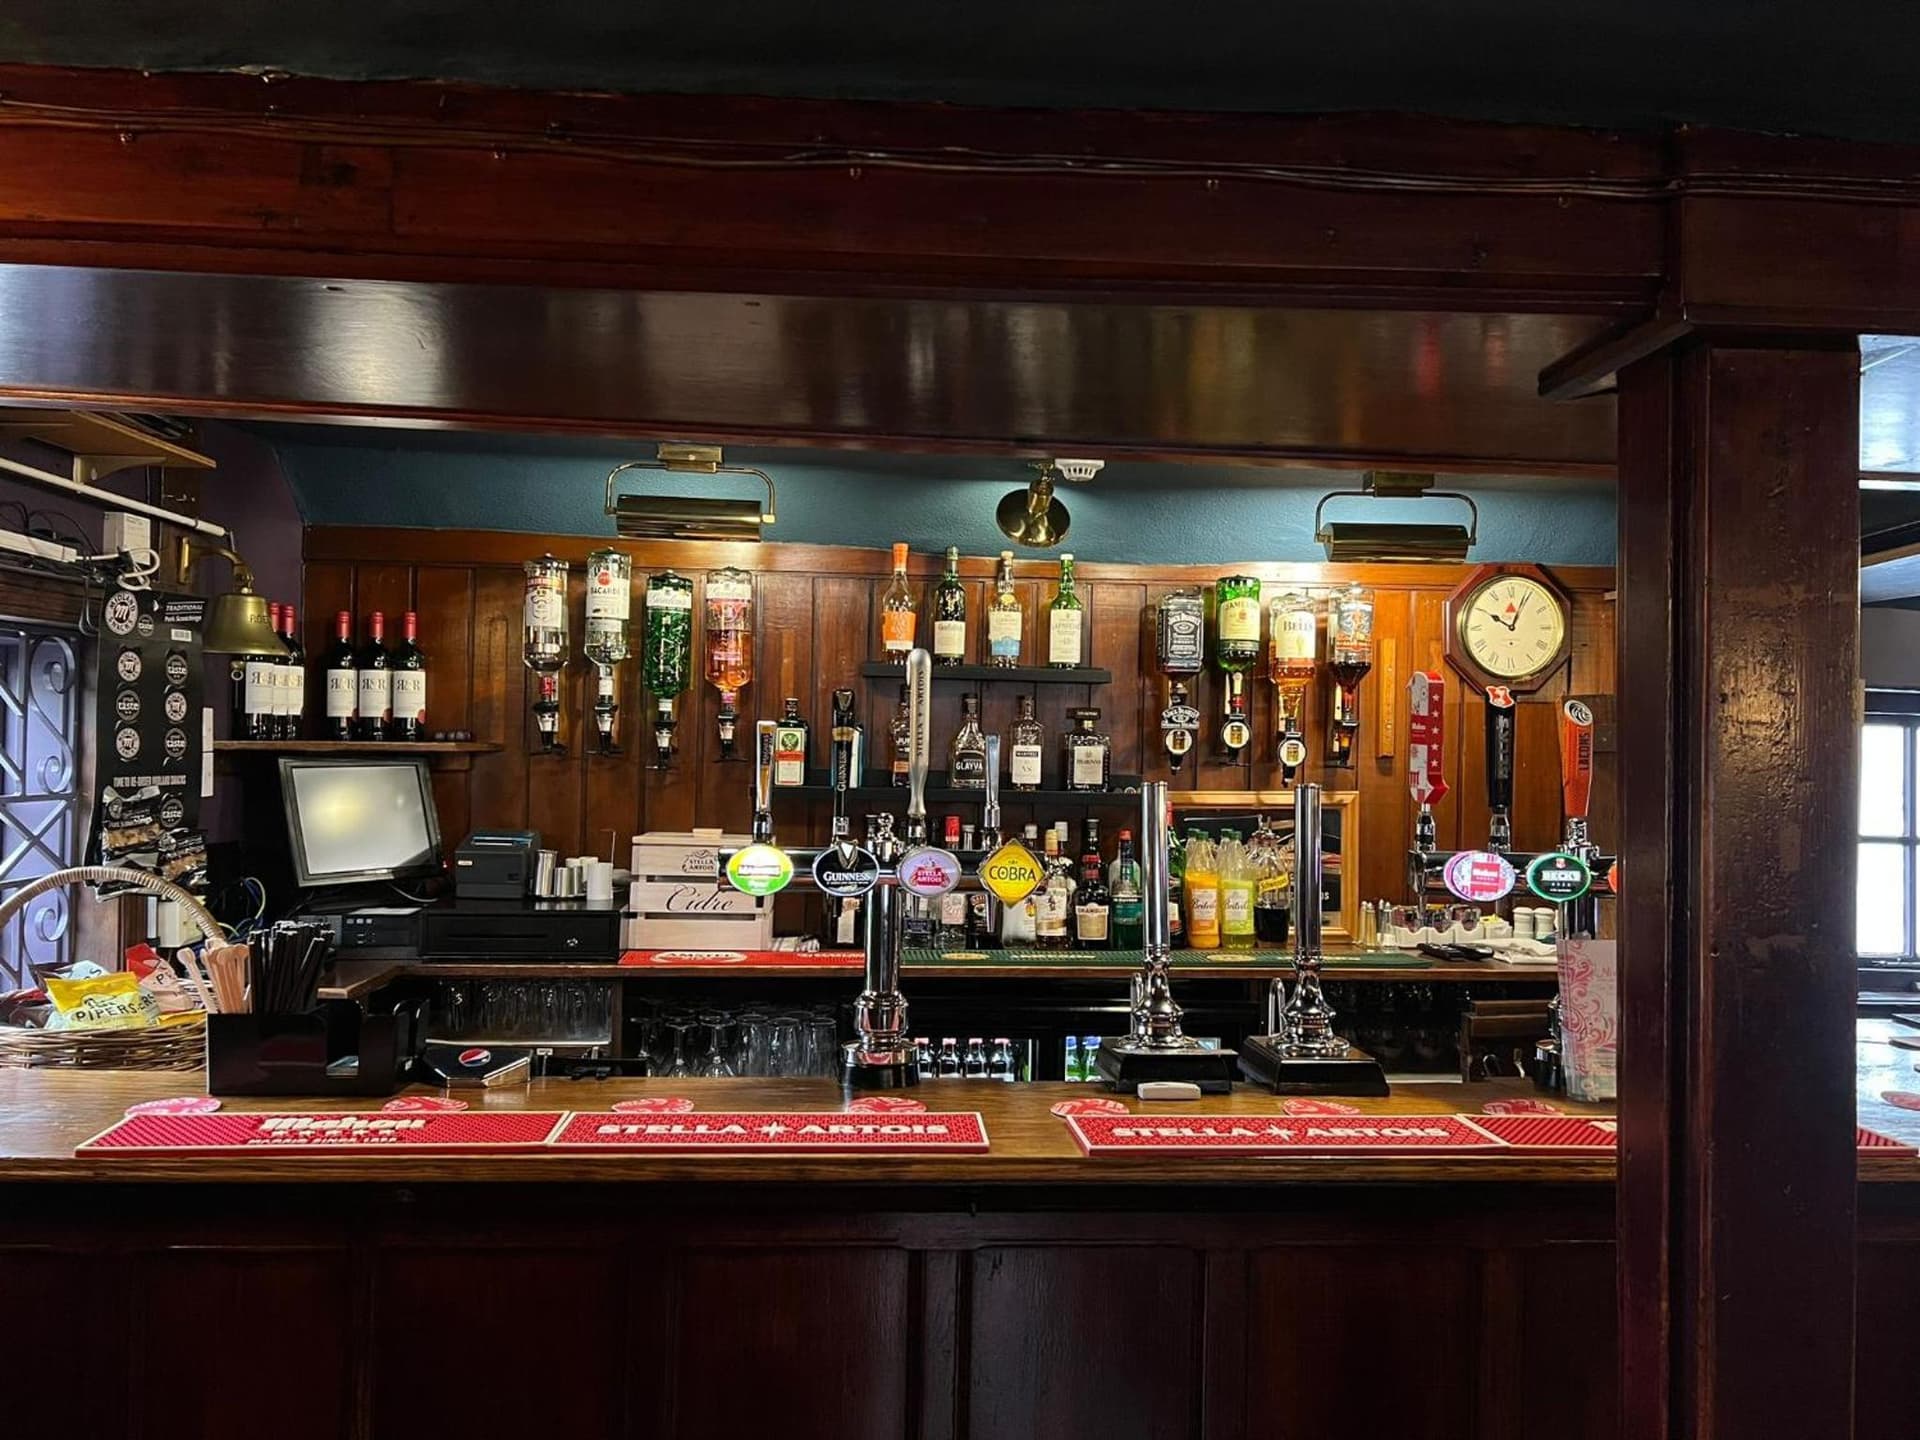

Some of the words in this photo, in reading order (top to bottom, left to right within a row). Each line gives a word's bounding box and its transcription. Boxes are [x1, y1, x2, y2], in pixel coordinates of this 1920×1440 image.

[109, 594, 136, 612] MIDLAND
[836, 750, 848, 792] GUINNESS
[955, 761, 983, 771] GLAYVA
[822, 871, 872, 882] GUINNESS
[989, 865, 1037, 882] COBRA
[666, 885, 734, 911] Cidre
[75, 1002, 138, 1022] PIPERS
[259, 1116, 427, 1130] Mahou
[596, 1123, 748, 1135] STELLA
[798, 1123, 950, 1135] ARTOIS
[1111, 1126, 1256, 1138] STELLA
[1304, 1126, 1452, 1138] ARTOIS
